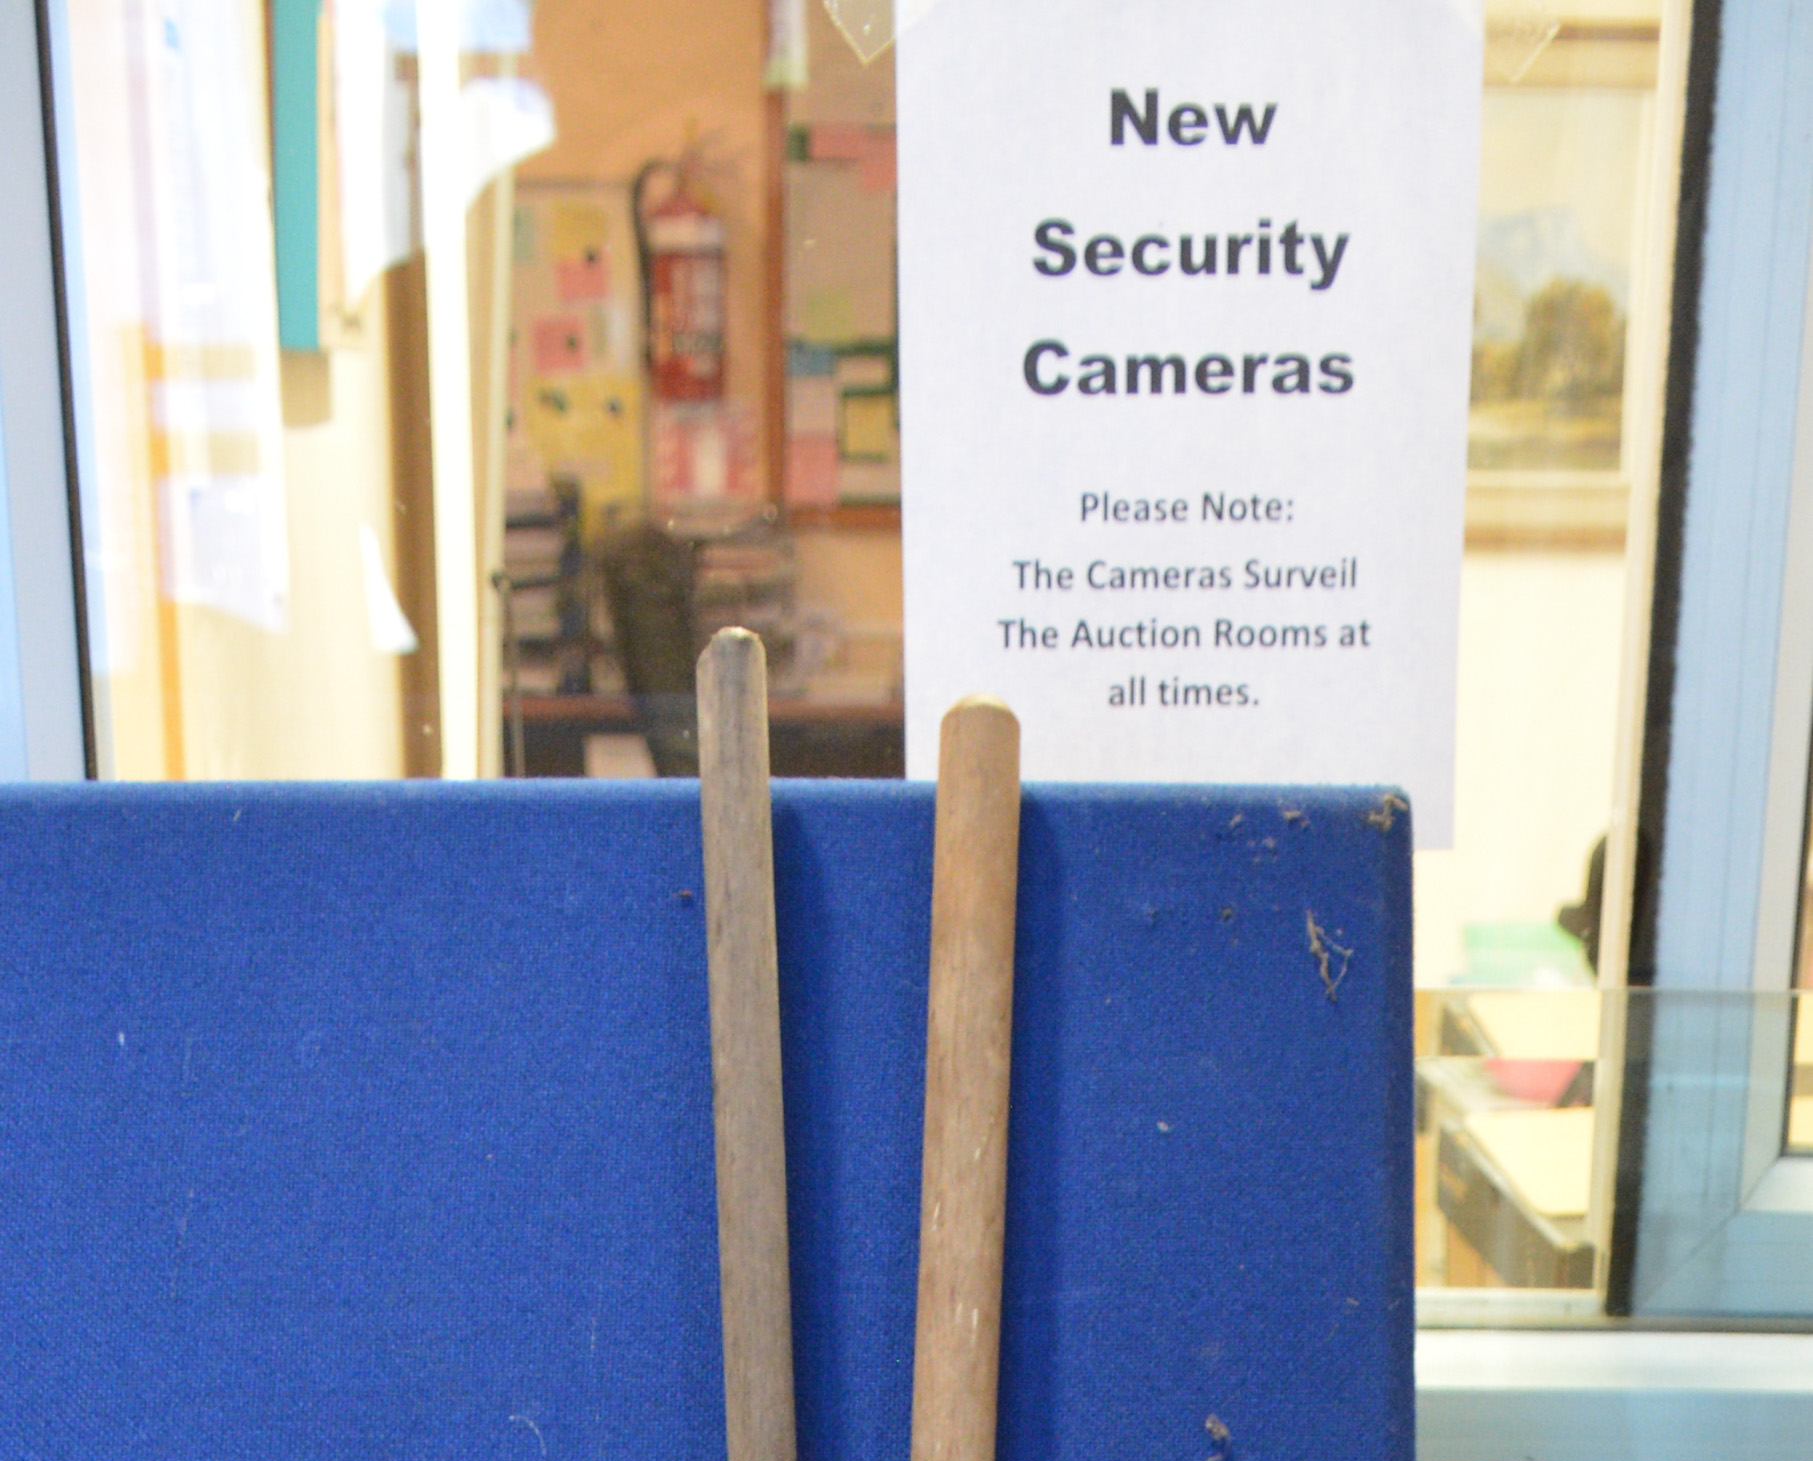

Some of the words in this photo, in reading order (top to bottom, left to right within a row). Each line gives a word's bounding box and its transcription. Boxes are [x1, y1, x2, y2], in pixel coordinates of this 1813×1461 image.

[1109, 88, 1278, 147] New
[1032, 218, 1350, 291] Security
[1022, 339, 1355, 397] Cameras
[1080, 491, 1188, 523] Please
[1201, 491, 1294, 522] Note:
[1012, 559, 1074, 590] The
[1085, 560, 1233, 590] Cameras
[1243, 558, 1358, 590] Surveil
[997, 619, 1059, 650] The
[1070, 618, 1202, 649] Auction
[1212, 618, 1328, 648] Rooms
[1338, 621, 1371, 648] at
[1107, 677, 1147, 707] all
[1157, 677, 1260, 706] times.
